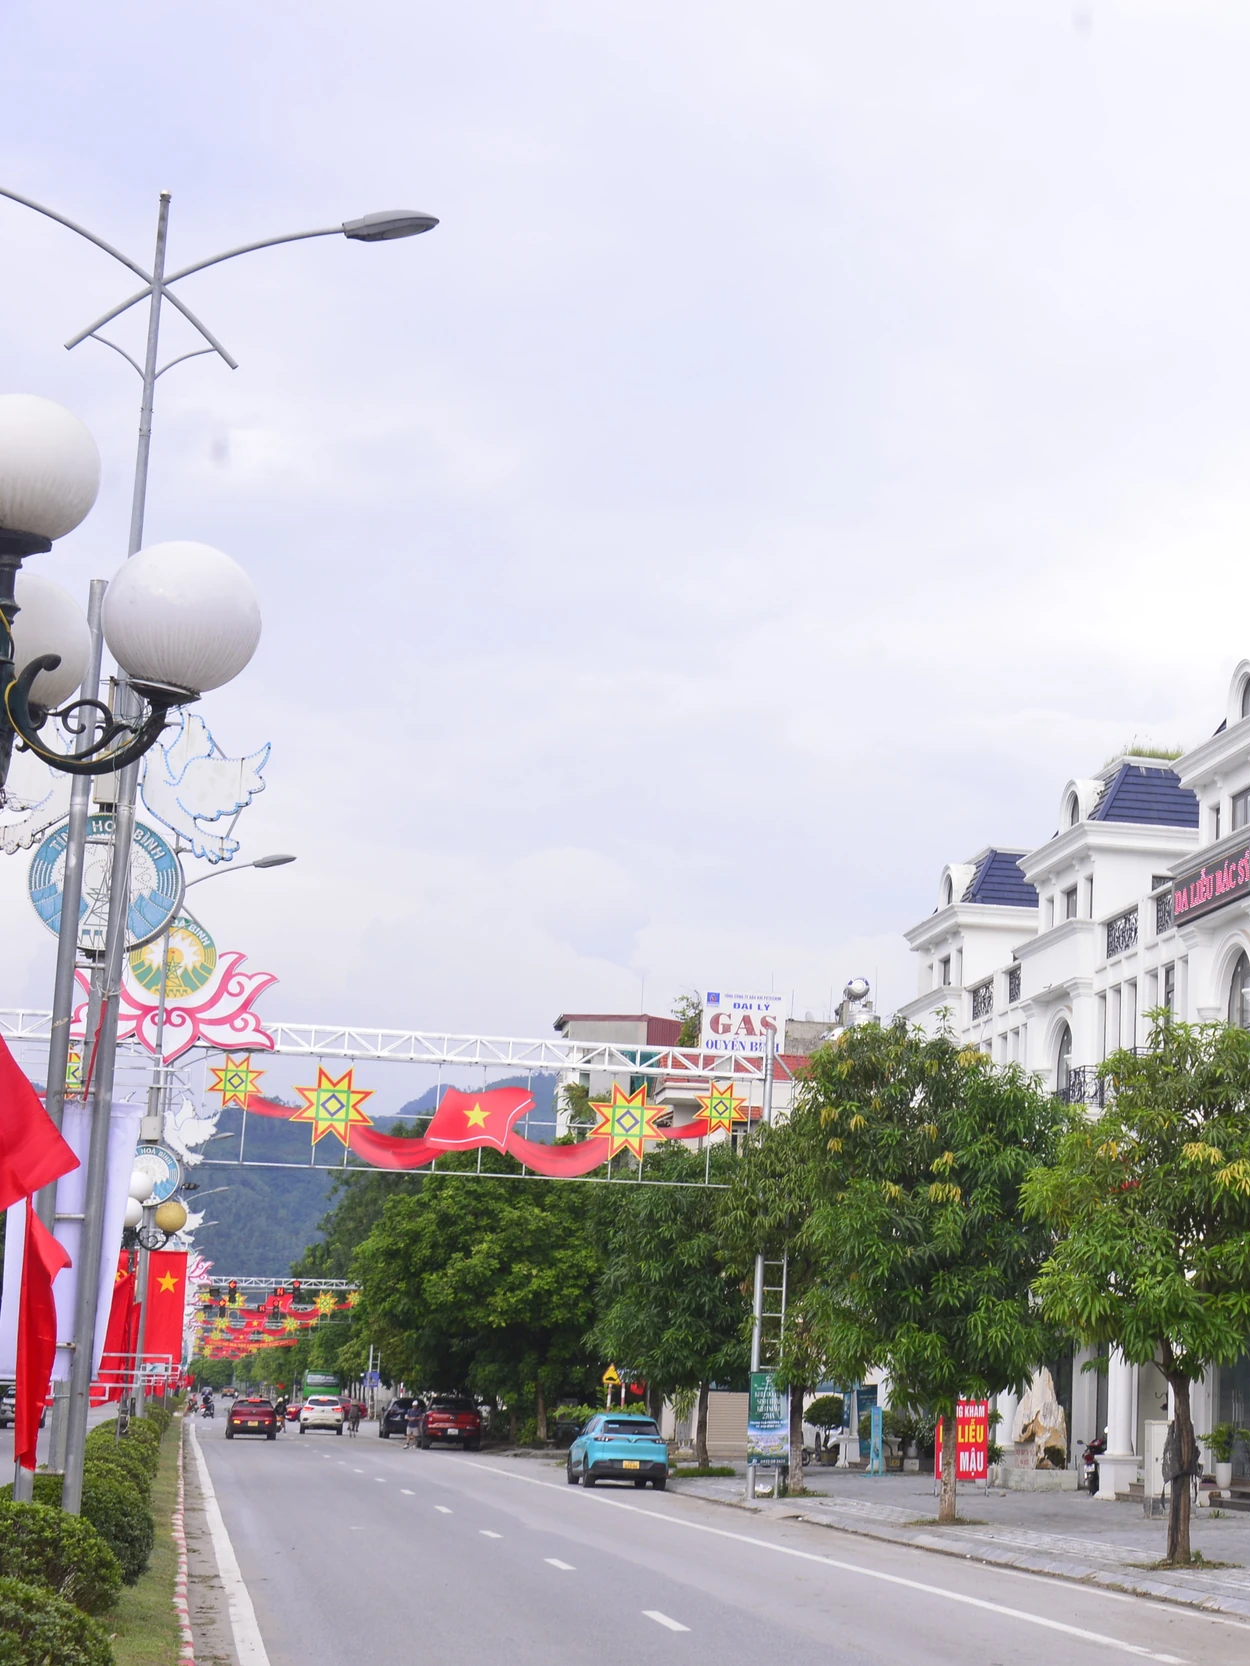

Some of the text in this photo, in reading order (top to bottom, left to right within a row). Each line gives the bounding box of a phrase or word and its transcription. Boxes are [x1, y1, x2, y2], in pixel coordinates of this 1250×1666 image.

[92, 820, 116, 832] HO
[1174, 887, 1189, 916] DA
[1189, 867, 1214, 908] LIỄU
[1215, 859, 1237, 896] BÁC
[733, 1001, 770, 1011] ĐẠI LÝ
[709, 1012, 777, 1037] GAS
[958, 1418, 984, 1443] LIỄU
[960, 1447, 984, 1476] MẬU
